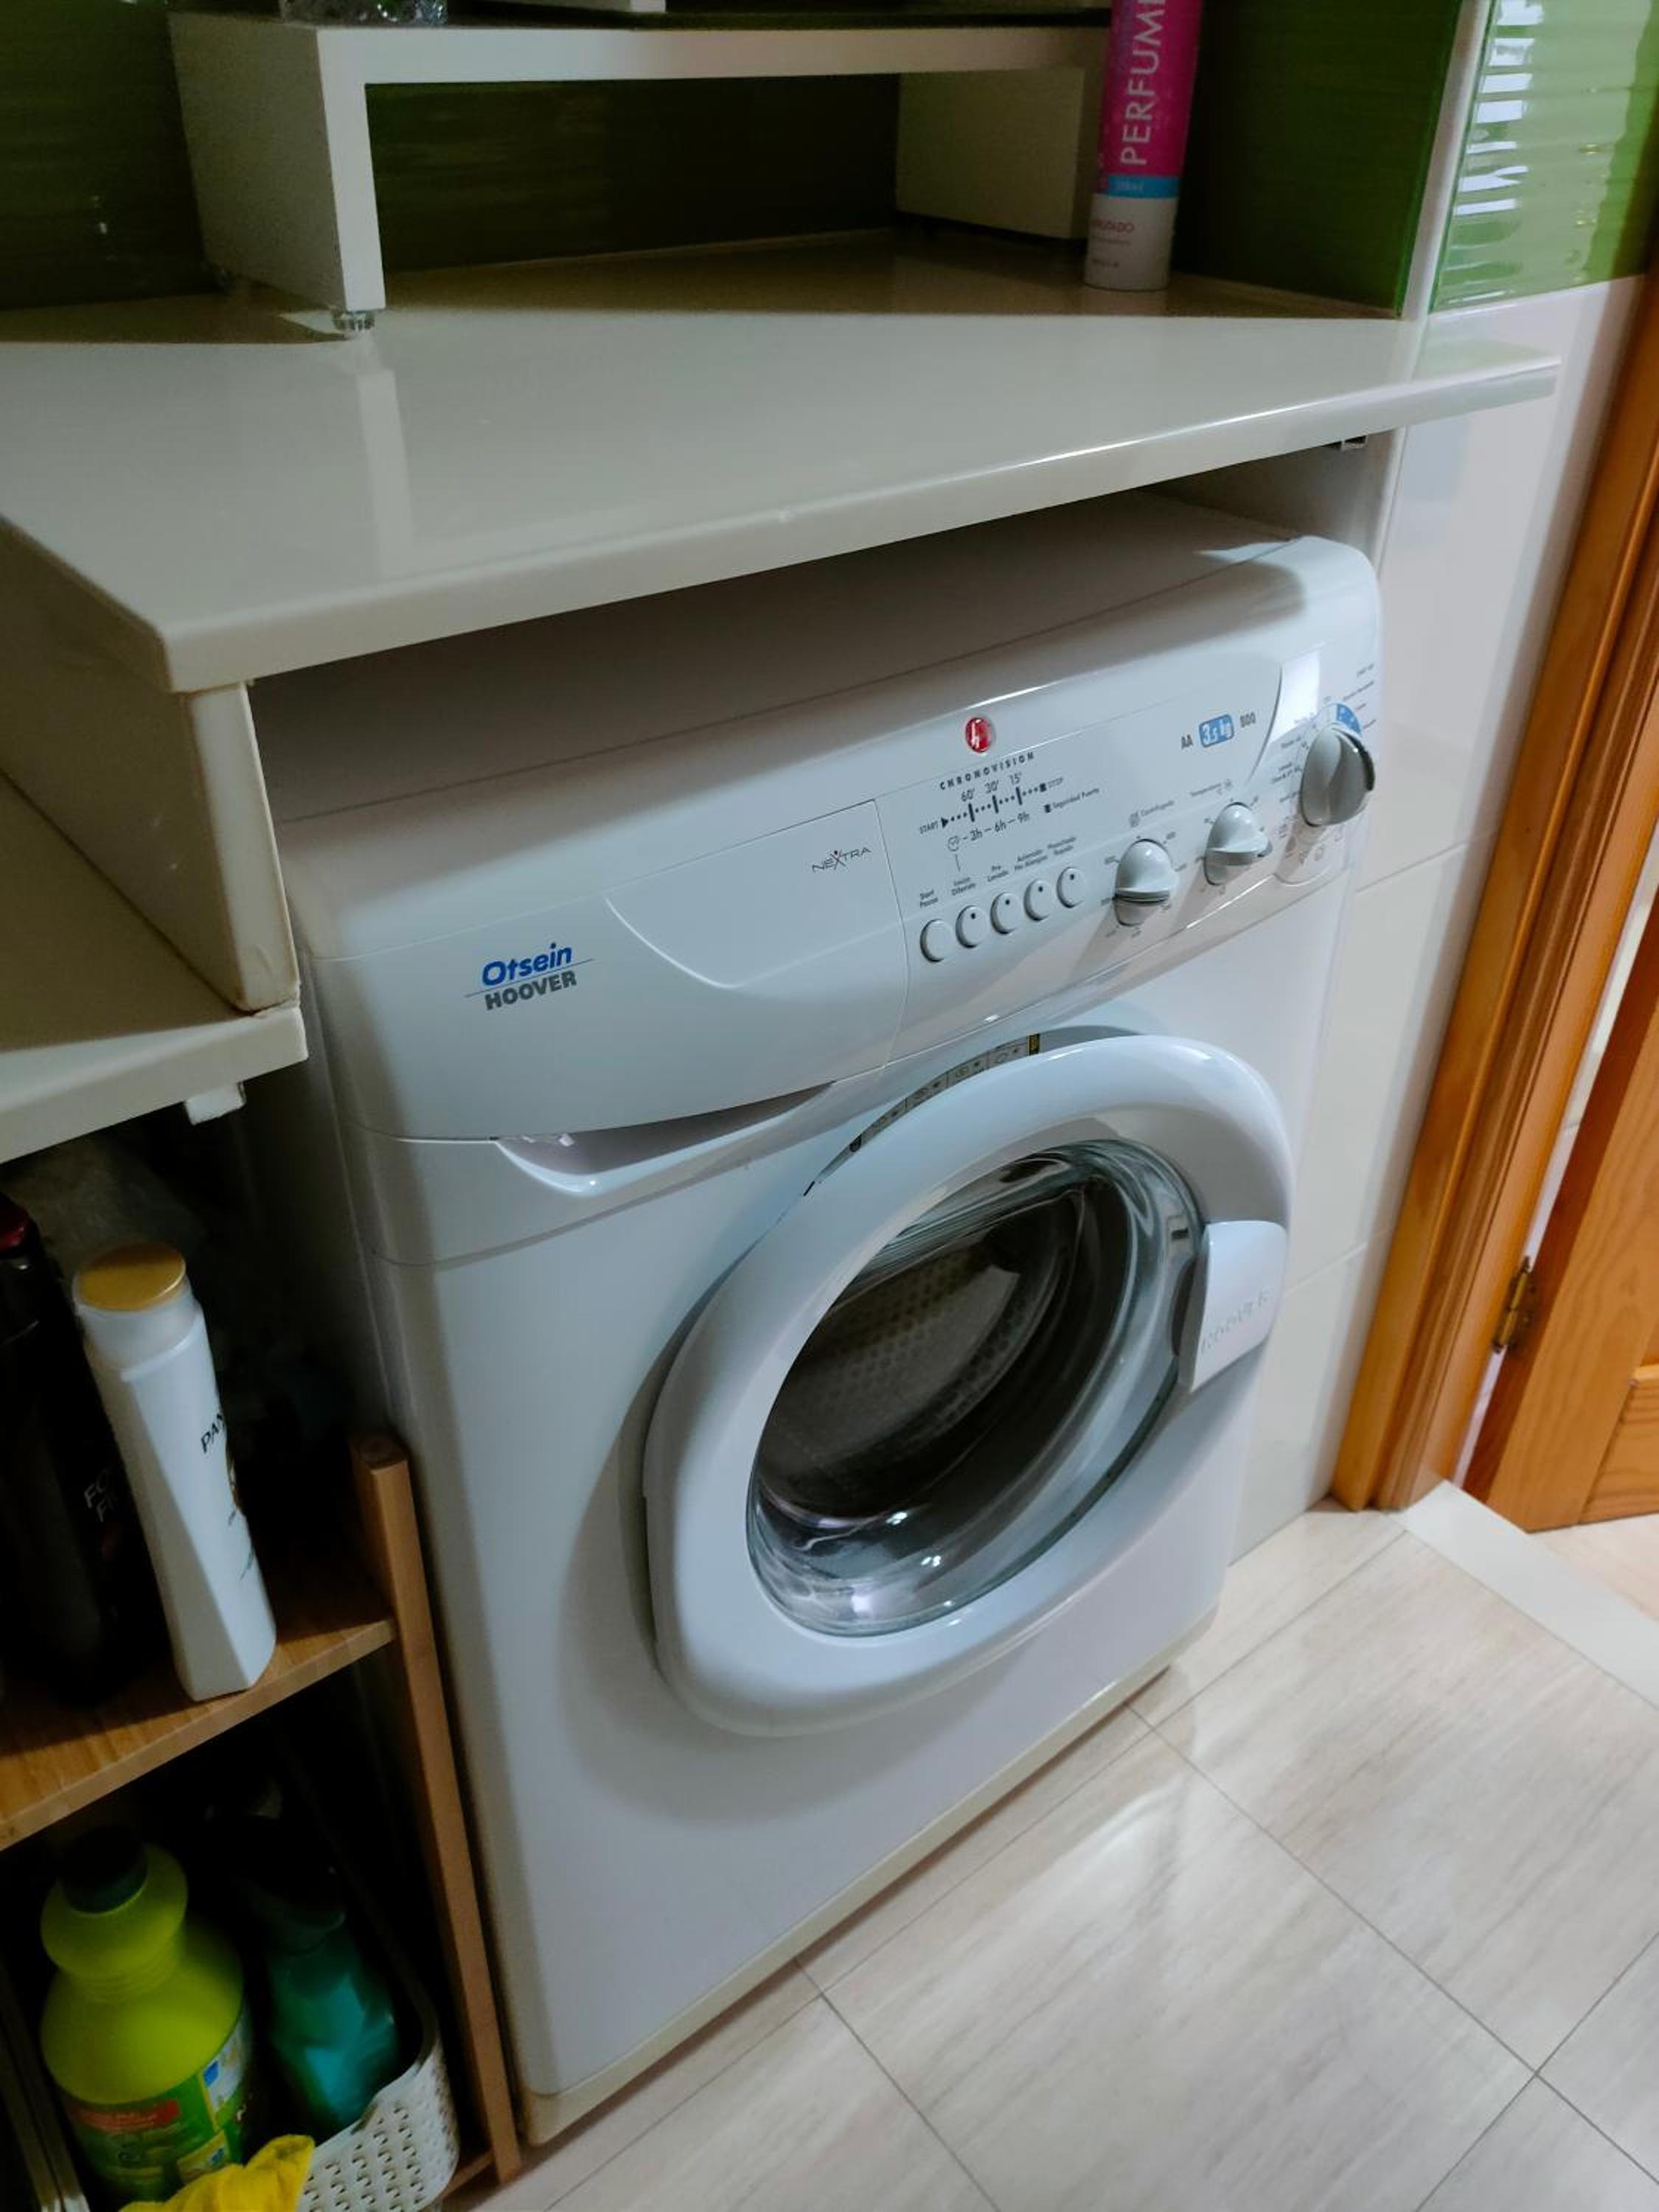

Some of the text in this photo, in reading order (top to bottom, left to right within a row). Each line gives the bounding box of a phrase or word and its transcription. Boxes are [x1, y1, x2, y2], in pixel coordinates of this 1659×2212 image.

[939, 751, 1034, 790] CHRONOVISION
[482, 942, 572, 987] Otsein
[484, 970, 577, 1010] HOOVER
